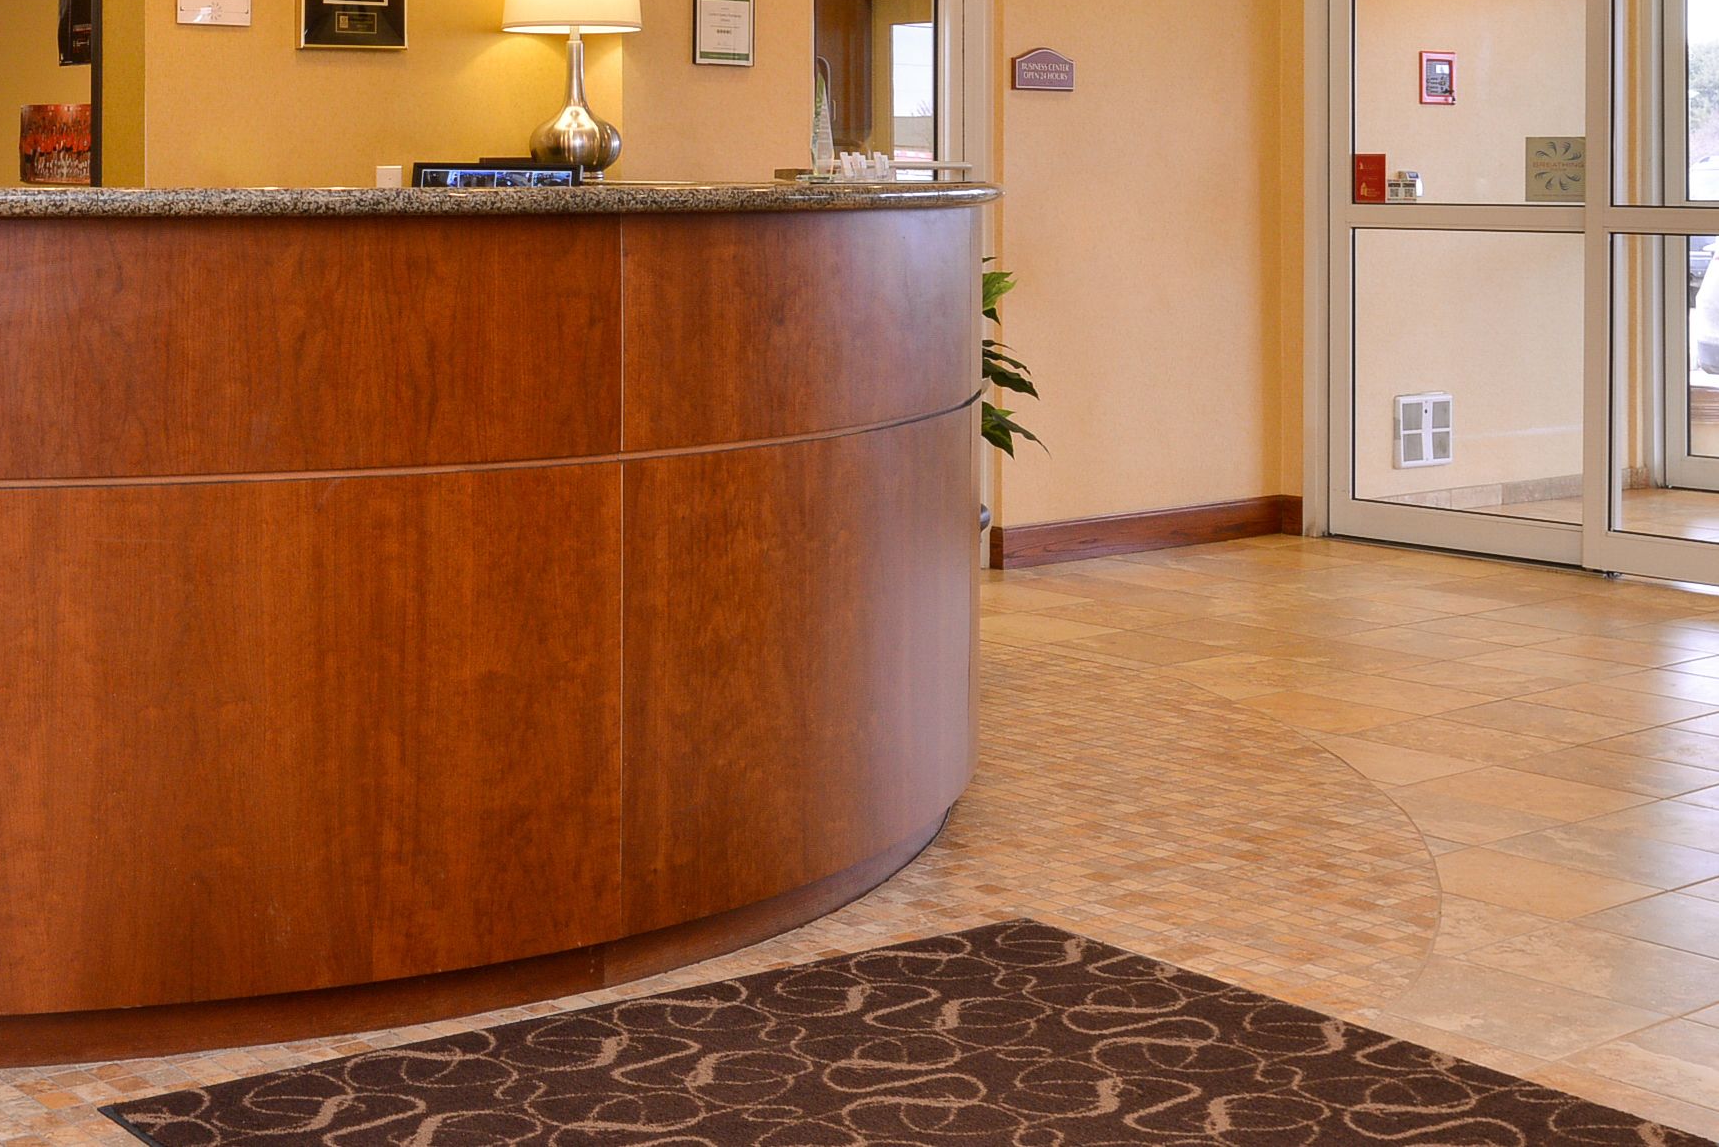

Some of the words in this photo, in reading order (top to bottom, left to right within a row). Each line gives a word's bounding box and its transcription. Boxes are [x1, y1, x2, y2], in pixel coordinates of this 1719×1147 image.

[1022, 62, 1047, 71] BUSINESS
[1049, 63, 1069, 71] CENTER
[1048, 72, 1068, 80] HOURS
